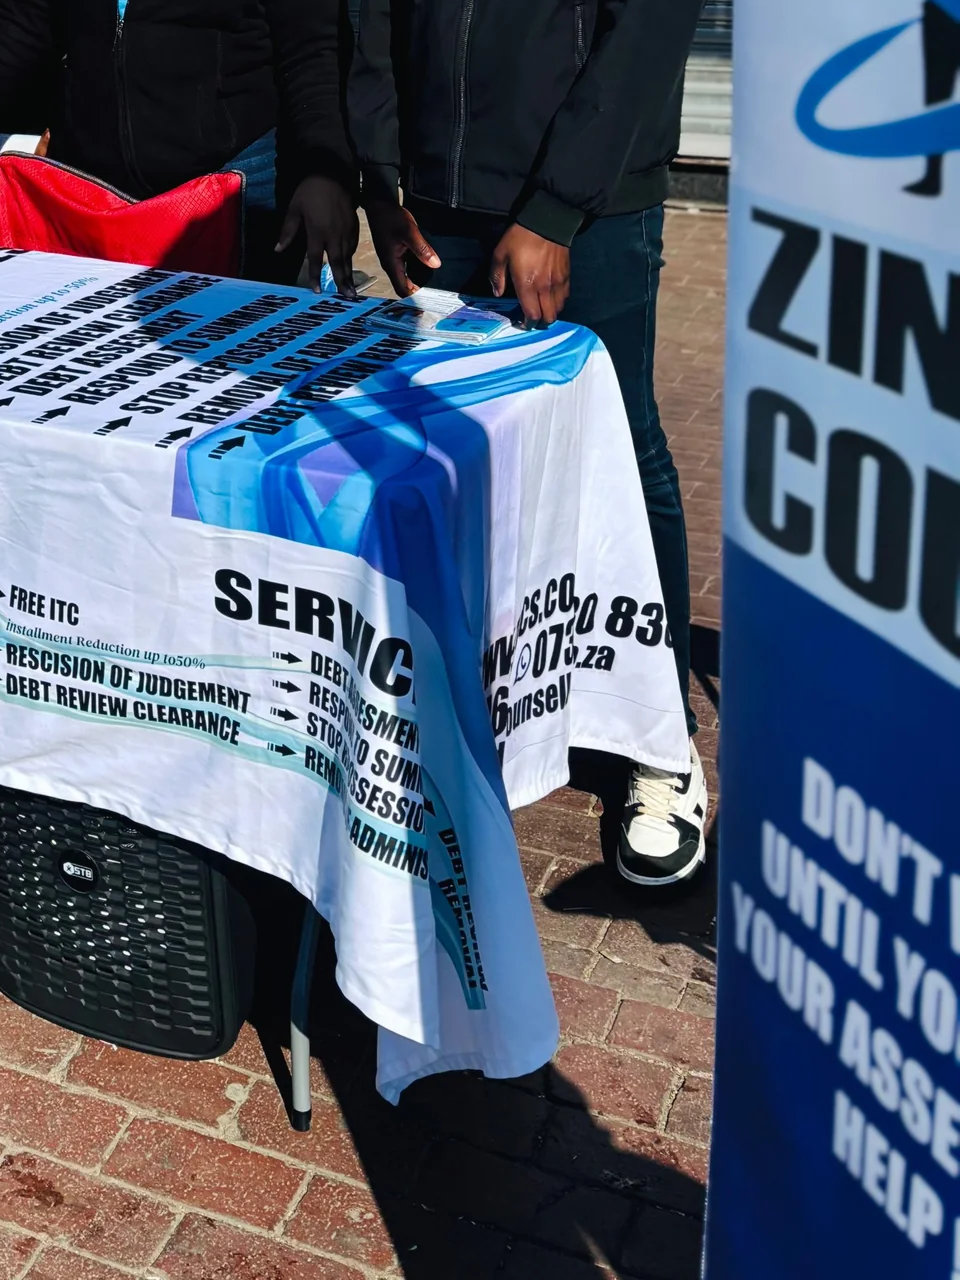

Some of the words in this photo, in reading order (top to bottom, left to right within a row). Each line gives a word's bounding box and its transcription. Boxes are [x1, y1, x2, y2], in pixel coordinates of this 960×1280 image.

[20, 320, 125, 361] REVIEW
[102, 274, 224, 322] CLEARANCE
[33, 311, 82, 327] OF
[34, 293, 57, 306] up
[54, 284, 71, 297] to
[746, 205, 960, 424] ZIN
[7, 364, 92, 397] DEBT
[57, 352, 184, 406] RESPOND
[156, 338, 211, 355] TO
[186, 293, 300, 342] SUMMONS
[119, 380, 200, 415] STOP
[175, 312, 335, 384] REPOSSESSION
[308, 298, 354, 315] OF
[176, 370, 300, 426] REMOVAL
[271, 355, 324, 372] OF
[234, 399, 317, 436] DEBT
[287, 358, 386, 403] REVIEW
[8, 584, 46, 618] FREE
[49, 597, 80, 627] ITC
[214, 568, 417, 707] SERVIC
[5, 618, 80, 646] installment
[76, 635, 141, 659] Reduction
[142, 650, 162, 666] up
[162, 654, 207, 670] to50%
[5, 642, 108, 685] RESCISION
[108, 663, 140, 691] OF
[138, 670, 252, 715] JUDGEMENT
[310, 650, 350, 693] DEBT
[5, 672, 52, 704] DEBT
[56, 683, 128, 718] REVIEW
[132, 700, 242, 746] CLEARANCE
[306, 711, 345, 756] STOP
[74, 866, 92, 879] STB
[802, 756, 943, 926] DON'T
[731, 880, 836, 1046] YOUR
[761, 819, 884, 991] UNTIL
[893, 935, 960, 1064] YO
[832, 1088, 943, 1250] HELP
